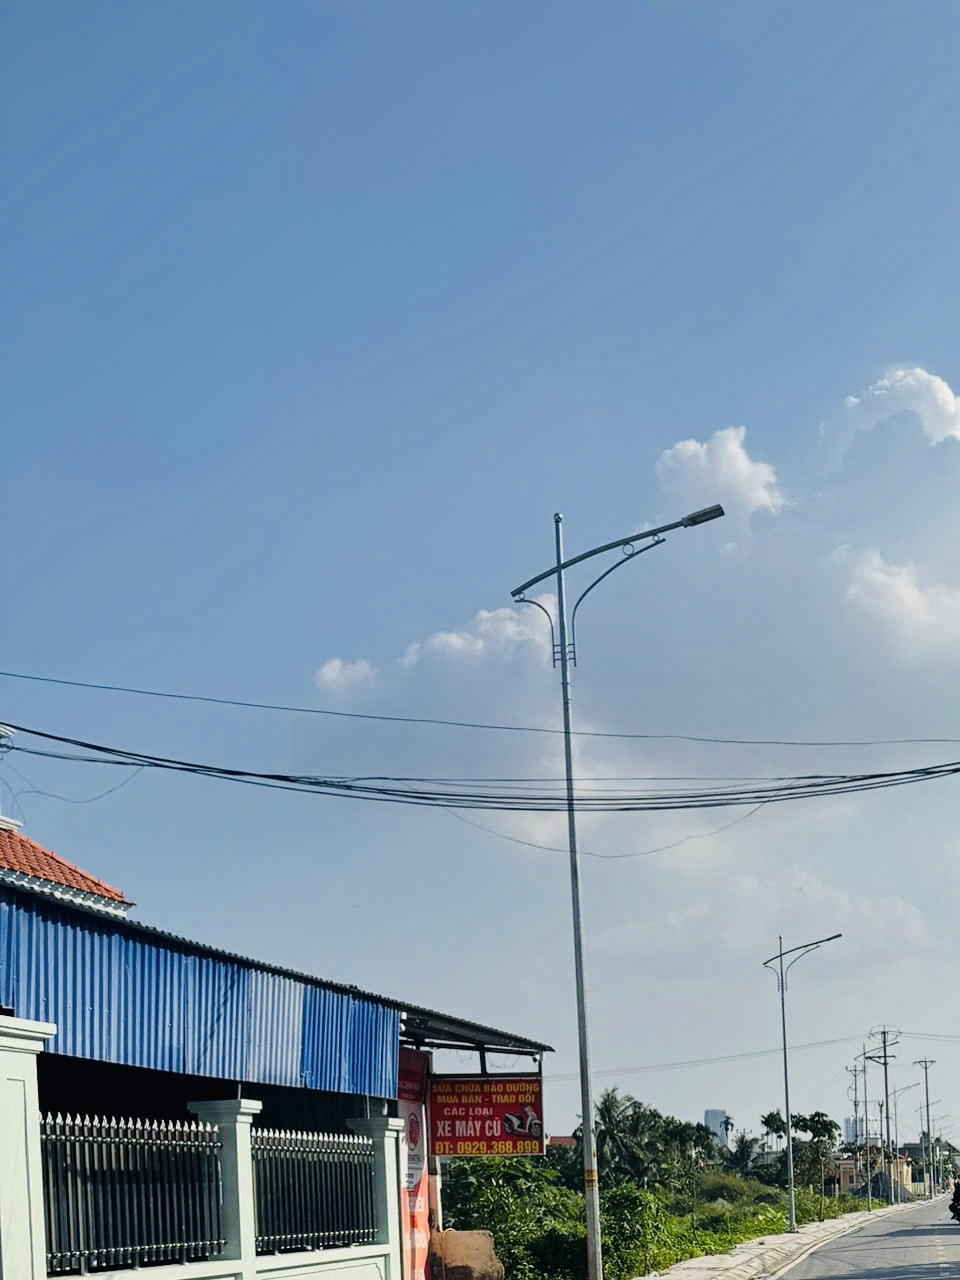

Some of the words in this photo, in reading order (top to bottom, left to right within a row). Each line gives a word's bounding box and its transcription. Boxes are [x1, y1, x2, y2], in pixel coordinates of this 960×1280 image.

[437, 1095, 459, 1104] MUA
[491, 1094, 516, 1104] TRAO
[443, 1106, 466, 1116] CÁC
[469, 1107, 493, 1118] LOẠI
[436, 1120, 452, 1137] XE
[455, 1116, 482, 1137] MÁY
[485, 1116, 501, 1137] CŨ
[457, 1140, 539, 1154] 0929.368.899
